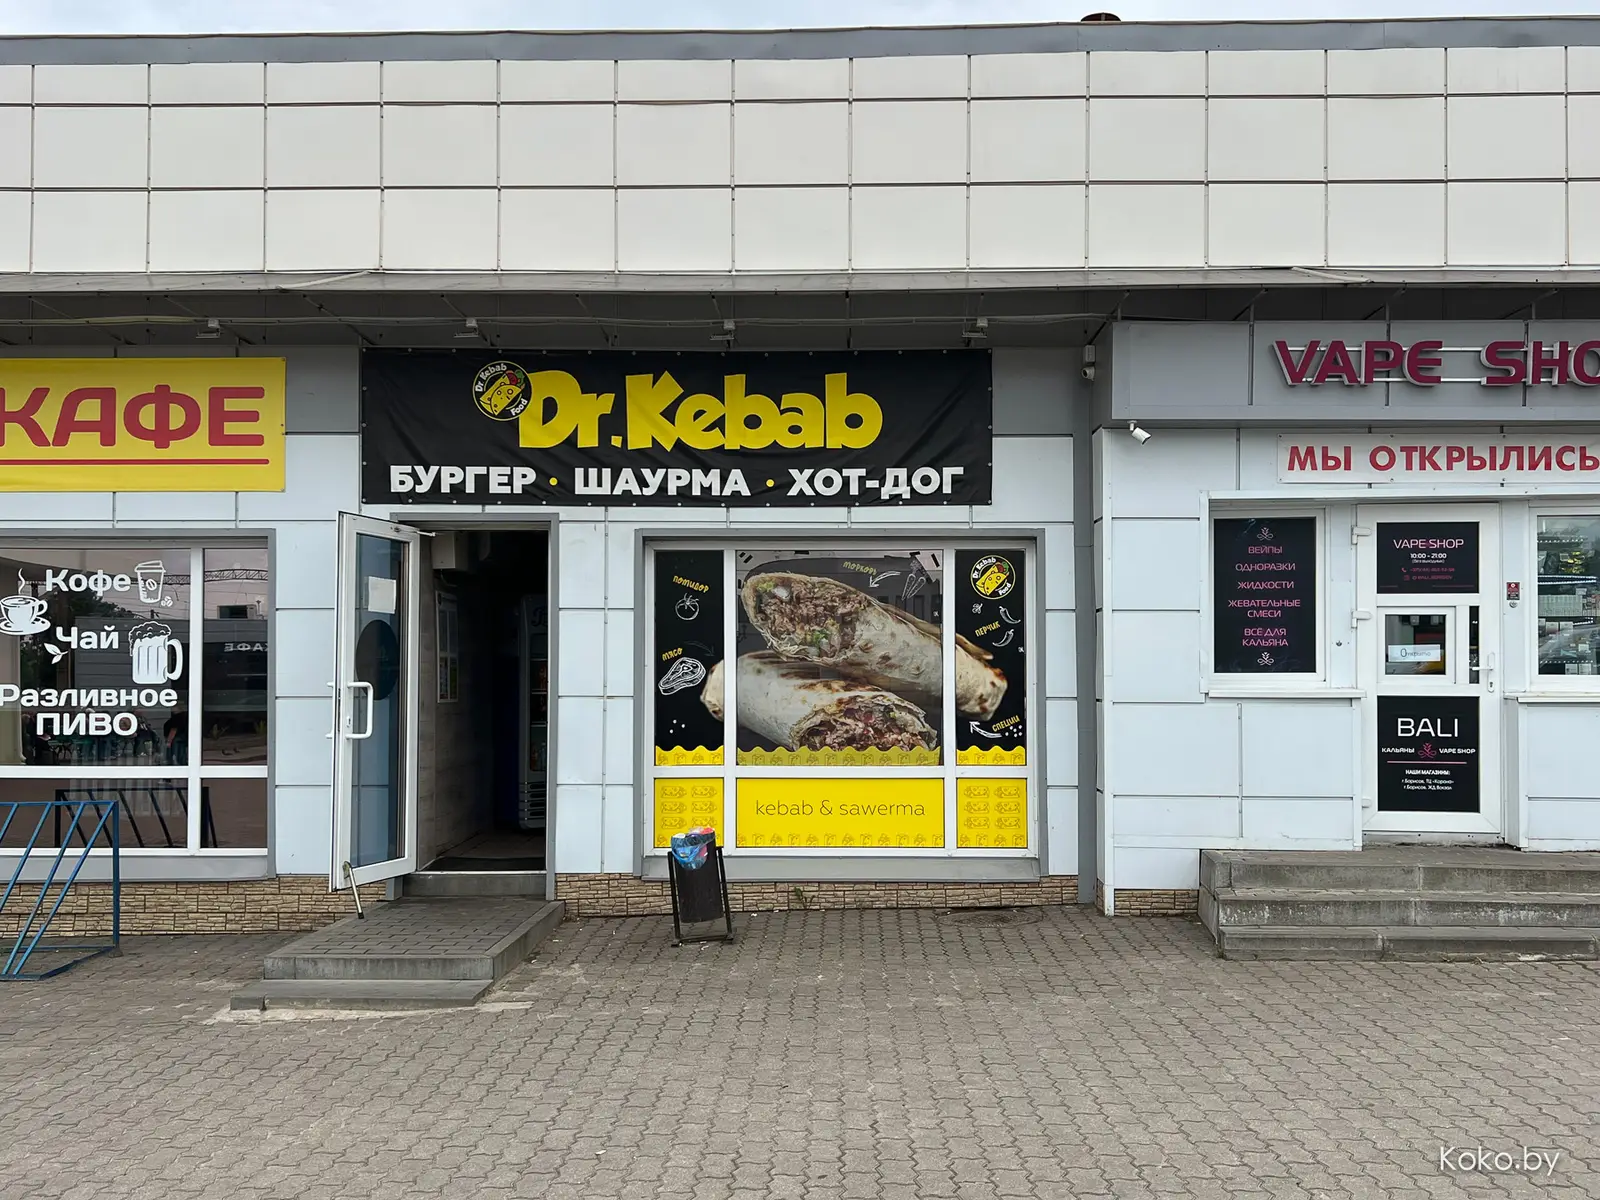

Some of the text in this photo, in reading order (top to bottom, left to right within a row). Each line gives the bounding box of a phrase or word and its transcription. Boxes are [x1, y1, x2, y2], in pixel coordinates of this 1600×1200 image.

[480, 363, 507, 380] Kebab
[1273, 341, 1443, 385] VAPE
[510, 398, 528, 416] Food
[0, 384, 265, 449] КАФЕ
[1288, 445, 1600, 471] МЫ ОТКРЫЛИСЬ
[390, 465, 964, 500] БУРГЕР ШАУРМА ХОТ-ДОГ
[1247, 545, 1283, 554] ВЕЙПЫ
[1393, 538, 1464, 549] VAPE SHOP
[1235, 563, 1296, 571] ОДНОРАЗКИ
[45, 569, 131, 597] Кофе
[1237, 581, 1295, 589] ЖИДКОСТИ
[1247, 609, 1282, 618] СМЕСИ
[56, 625, 119, 649] Чай
[1263, 628, 1287, 637] ДЛЯ
[1242, 639, 1288, 647] КАЛЬЯНА
[0, 684, 178, 707] Разливное
[36, 712, 138, 736] ПИВО
[1397, 717, 1459, 738] BALI
[755, 799, 926, 816] kebab & sawerma
